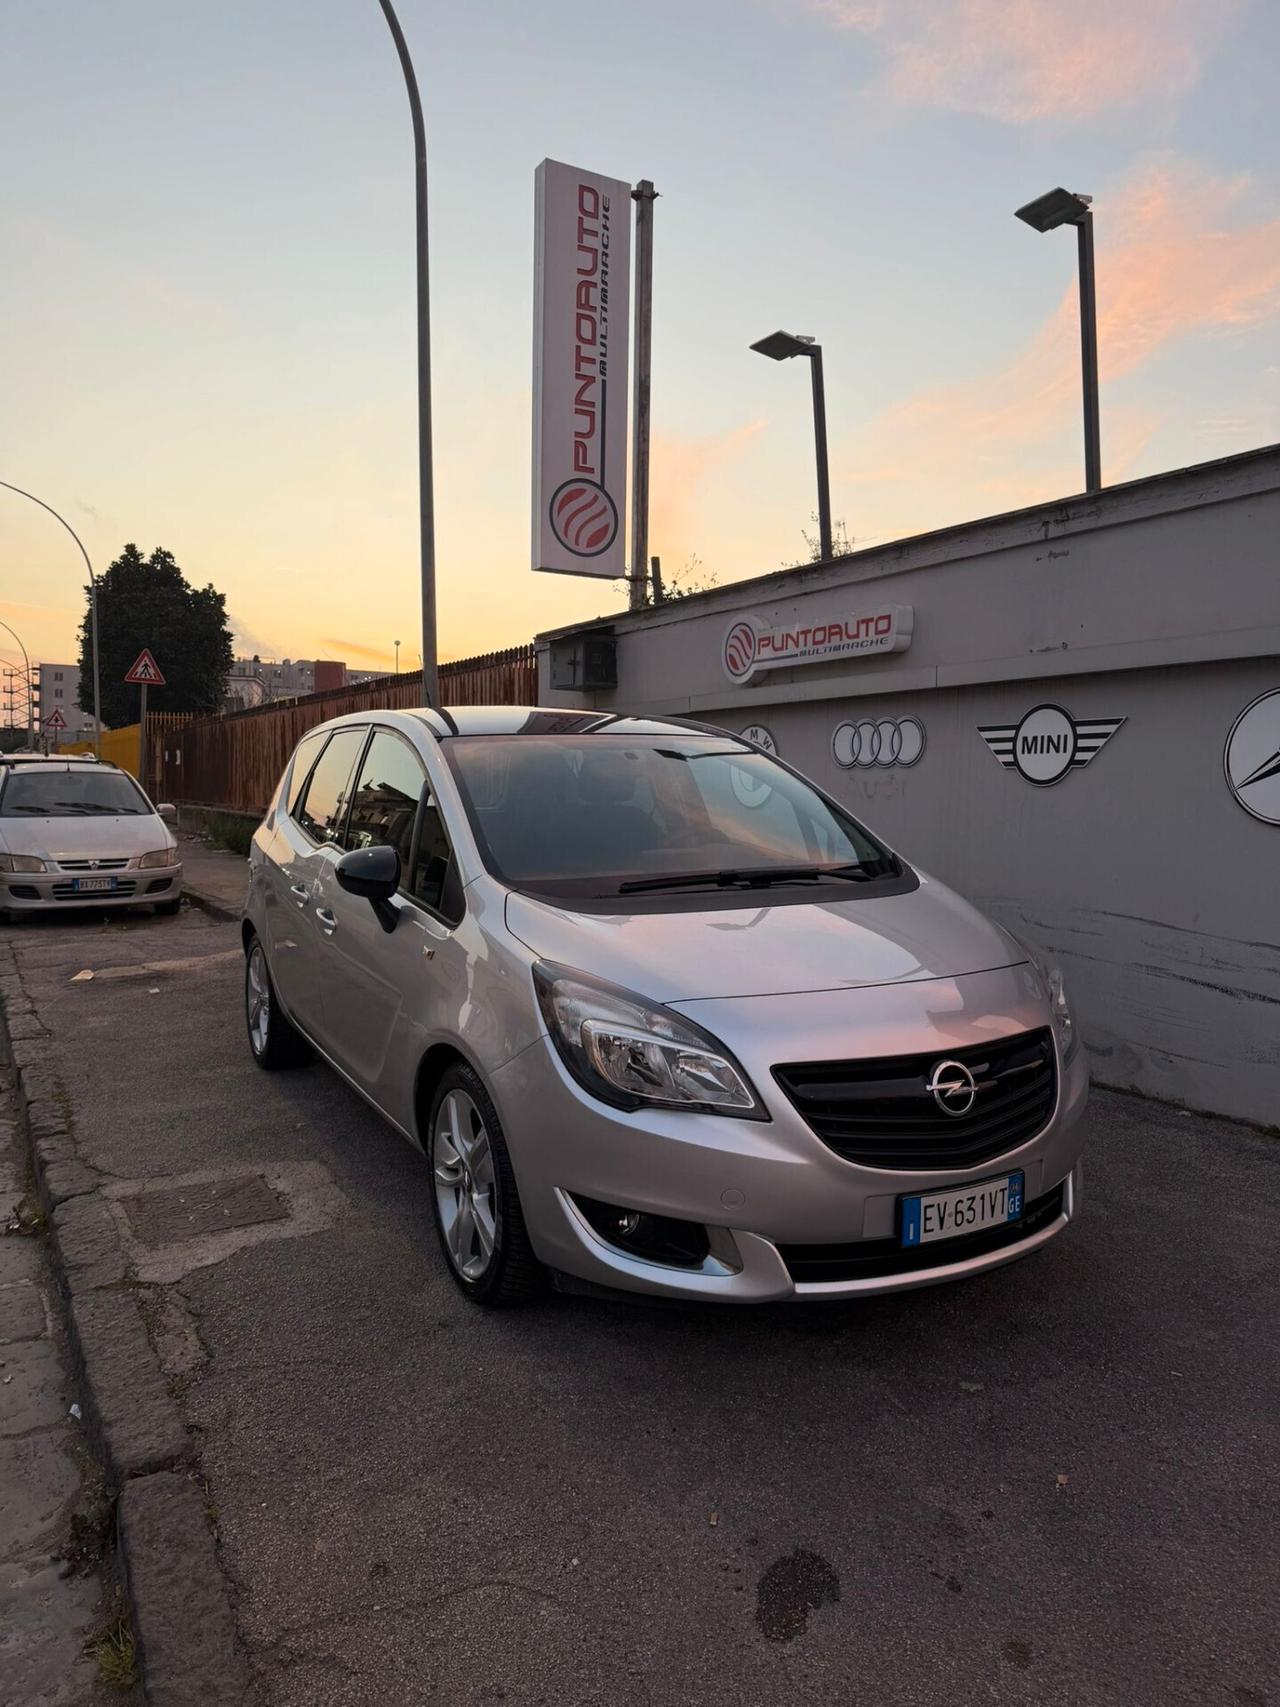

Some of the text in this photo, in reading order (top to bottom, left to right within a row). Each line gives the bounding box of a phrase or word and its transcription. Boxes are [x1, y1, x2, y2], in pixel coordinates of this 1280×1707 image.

[598, 194, 611, 377] MULTIMARCHE
[573, 184, 600, 474] PUNTOAUTO
[757, 614, 892, 655] PUNTOAUTO
[799, 636, 889, 657] MULTIMARCHE
[1021, 733, 1069, 755] MINI
[1008, 1195, 1021, 1214] GE
